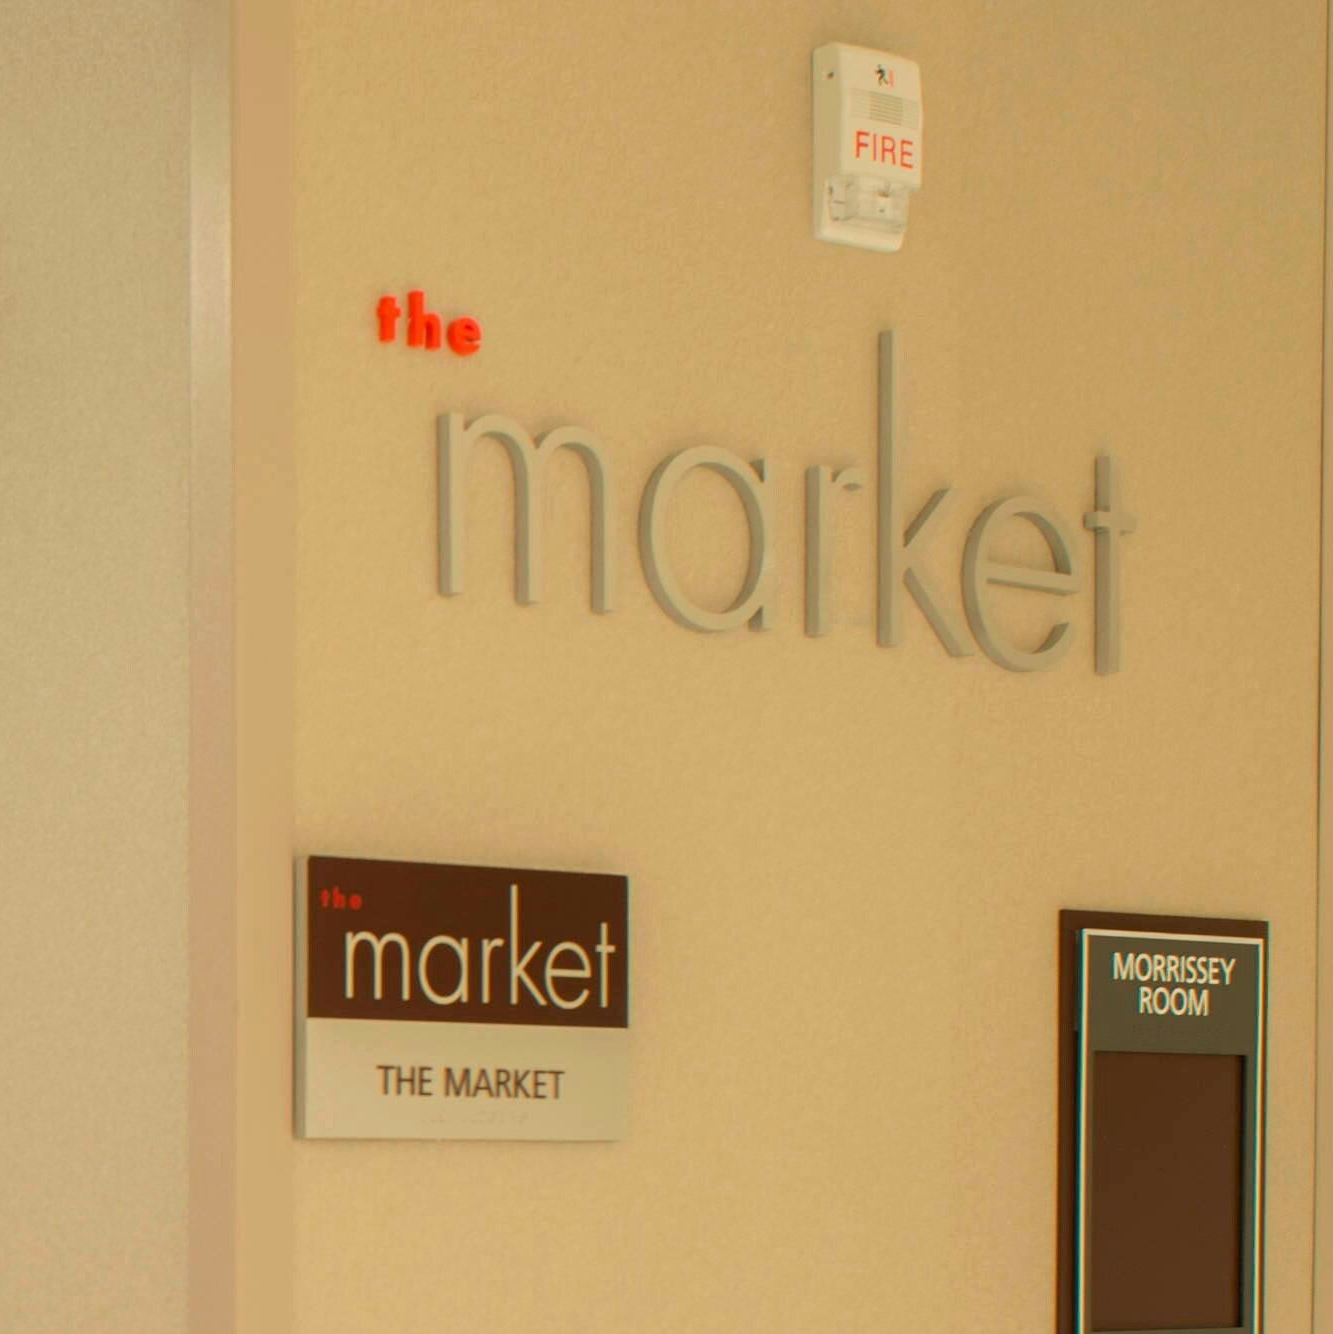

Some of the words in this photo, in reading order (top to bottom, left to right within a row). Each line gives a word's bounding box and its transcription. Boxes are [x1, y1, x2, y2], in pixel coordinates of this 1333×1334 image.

[854, 130, 914, 170] FIRE
[376, 290, 483, 355] the
[436, 328, 1137, 678] market
[320, 885, 363, 911] the
[344, 883, 617, 1010] market
[1112, 951, 1237, 986] MORRISSEY
[1138, 986, 1210, 1017] ROOM
[376, 1064, 433, 1097] THE
[443, 1066, 566, 1100] MARKET
